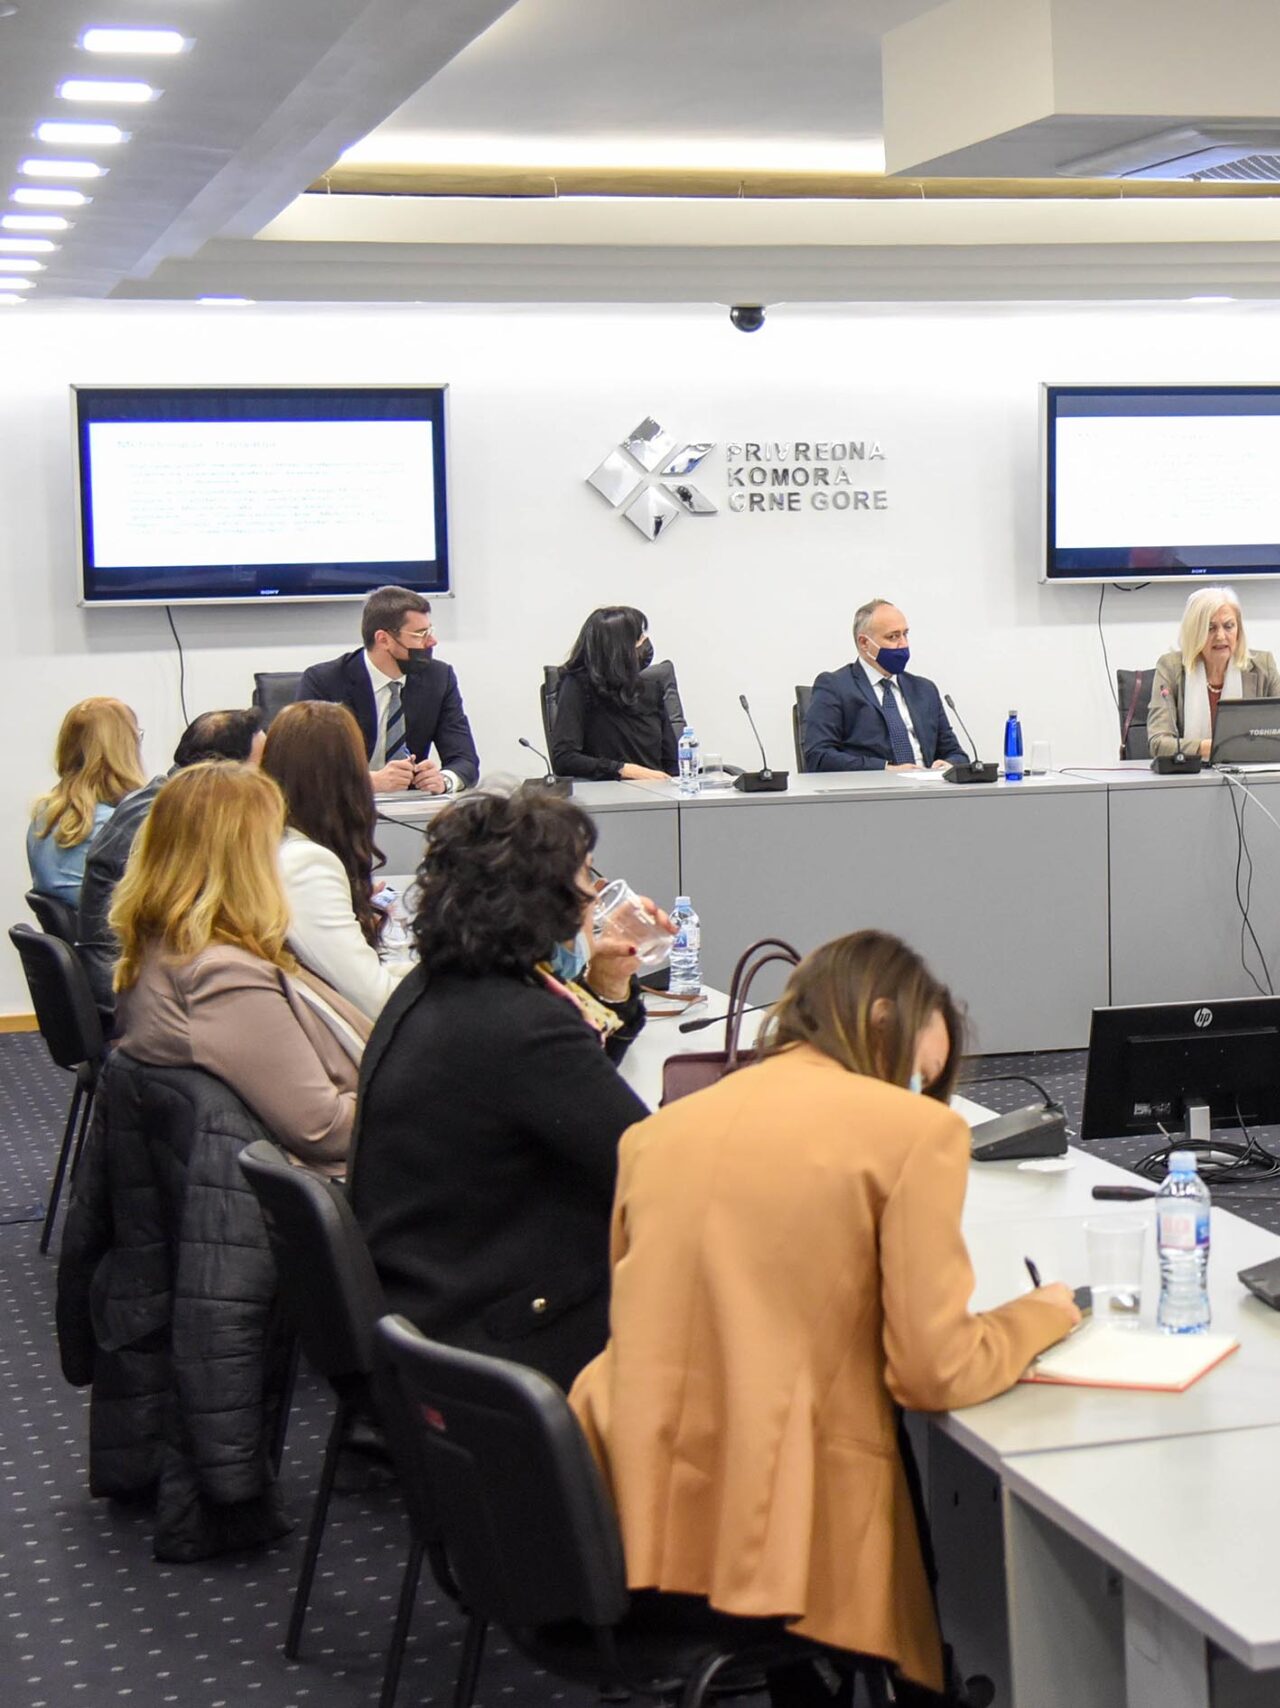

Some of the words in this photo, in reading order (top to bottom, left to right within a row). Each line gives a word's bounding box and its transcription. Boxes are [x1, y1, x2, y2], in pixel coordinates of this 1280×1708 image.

[726, 442, 886, 462] PRIVREDNA
[727, 466, 853, 487] KOMORA
[728, 491, 802, 512] CRNE
[811, 490, 889, 511] GORE
[1195, 1007, 1212, 1028] hp
